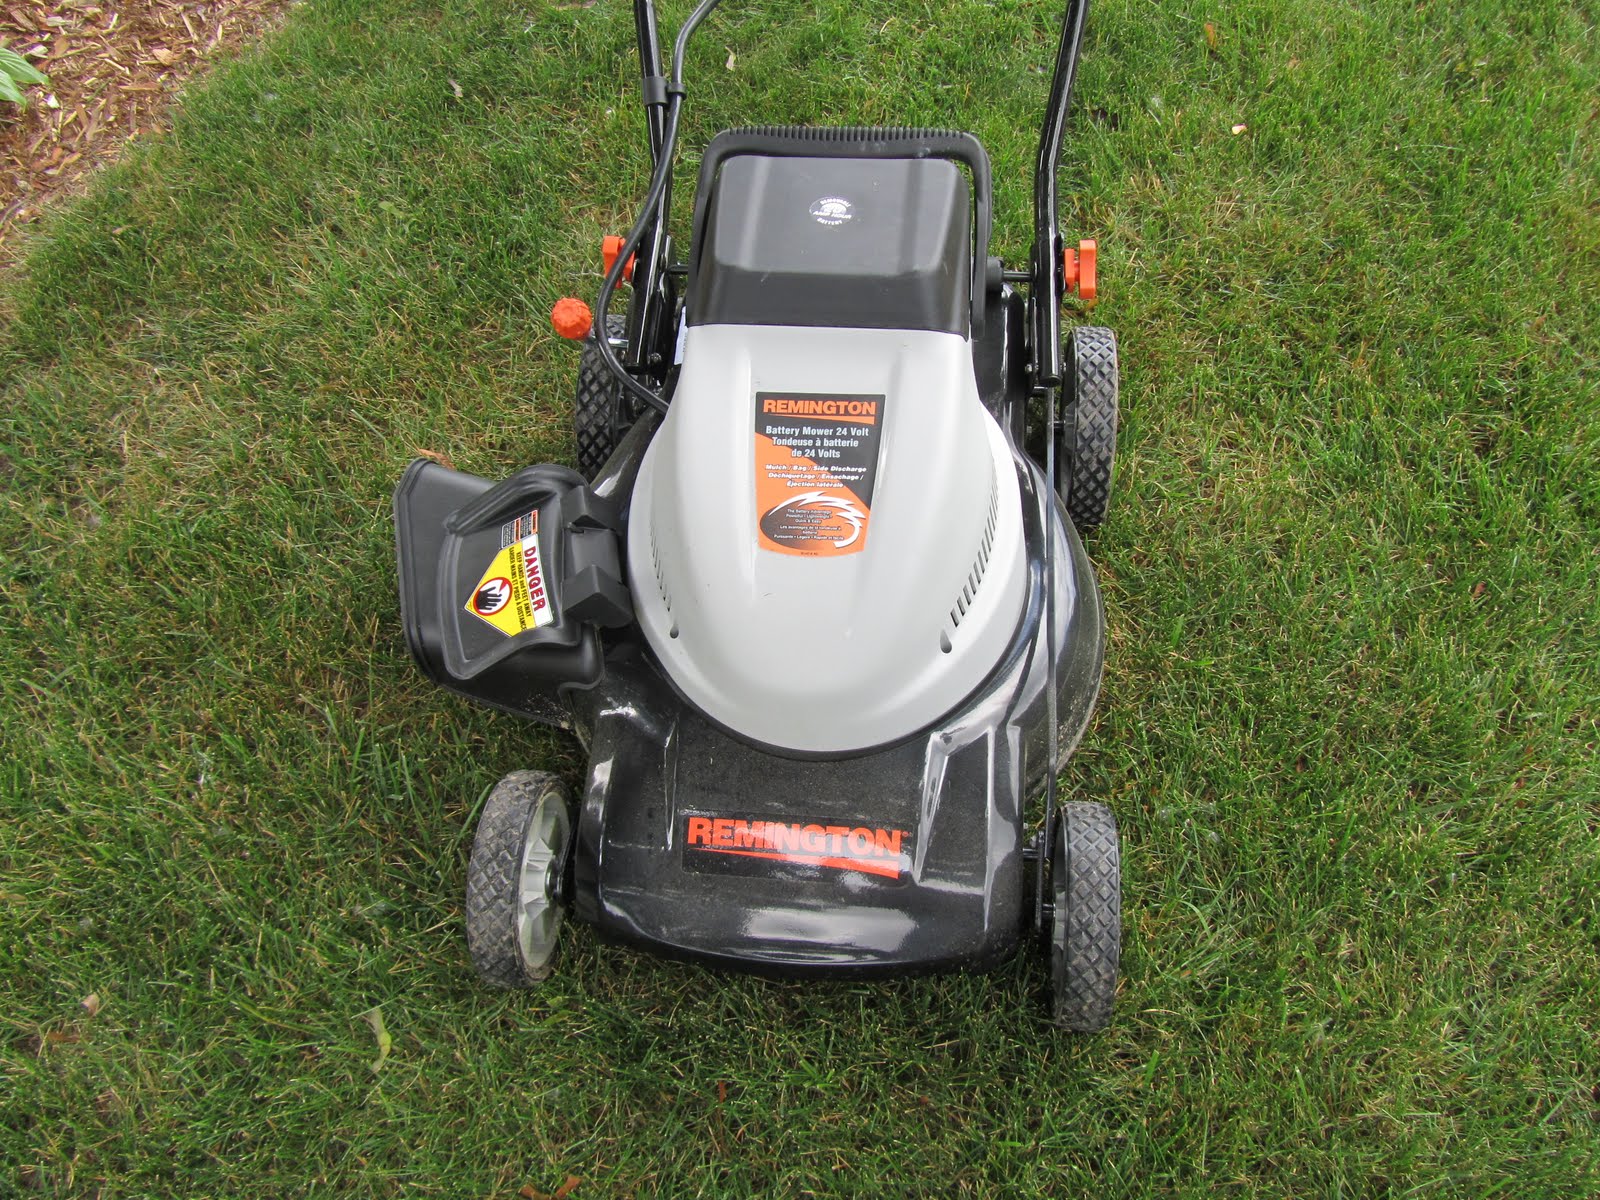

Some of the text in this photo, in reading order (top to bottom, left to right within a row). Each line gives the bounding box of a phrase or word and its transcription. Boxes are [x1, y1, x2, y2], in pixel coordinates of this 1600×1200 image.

[763, 399, 876, 415] REMINGTON
[766, 426, 869, 436] Battery Mower 24 Volt
[772, 436, 859, 448] Tondeuse à batterie
[792, 448, 841, 458] de 24 Volts
[524, 546, 546, 612] DANGER
[523, 603, 532, 618] AWAY
[686, 816, 902, 857] REMINGTON
